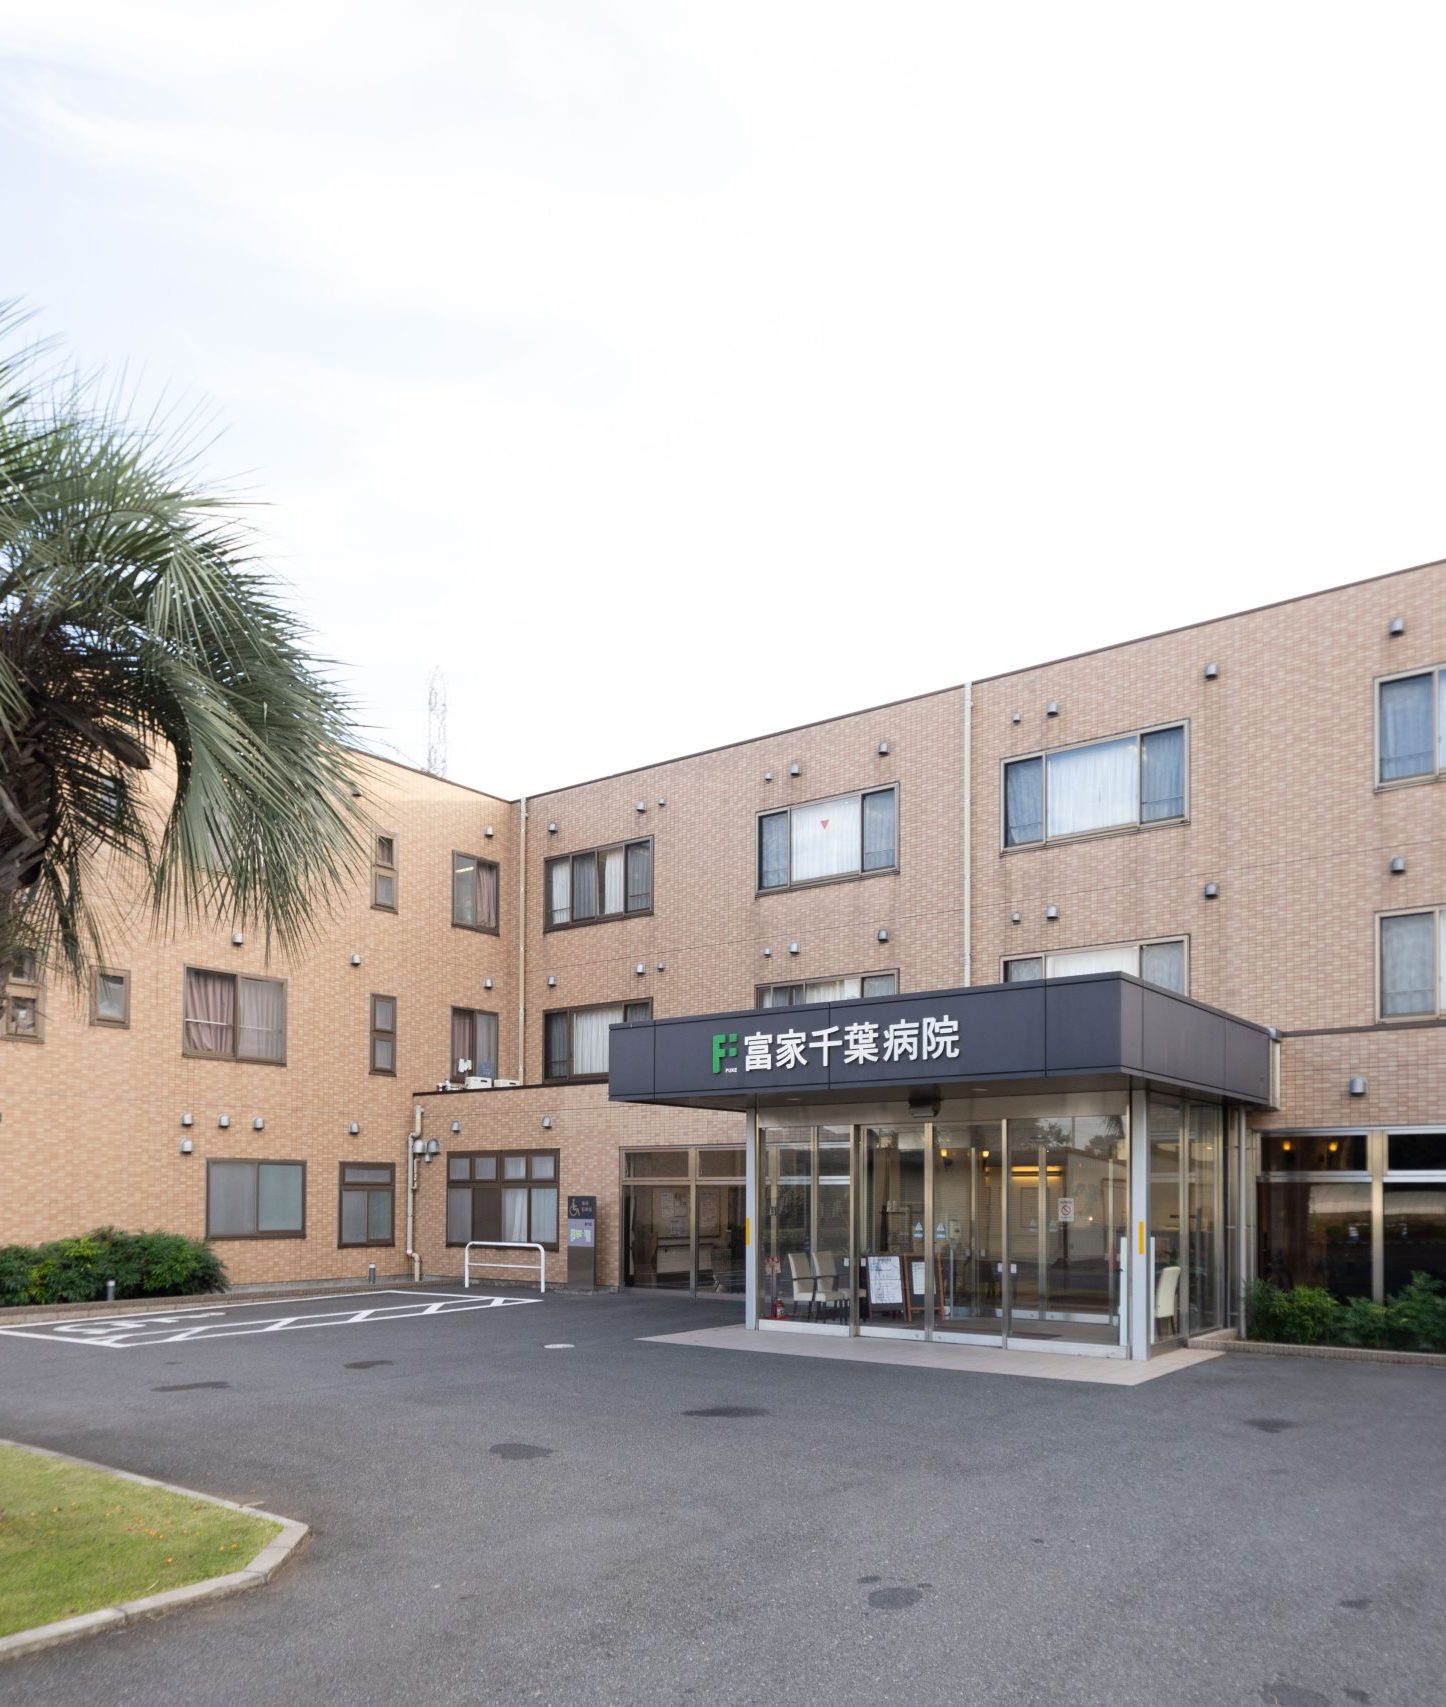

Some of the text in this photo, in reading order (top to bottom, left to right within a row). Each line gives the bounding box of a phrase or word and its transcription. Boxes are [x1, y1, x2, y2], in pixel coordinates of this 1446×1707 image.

[744, 1015, 960, 1072] 富家千葉病院
